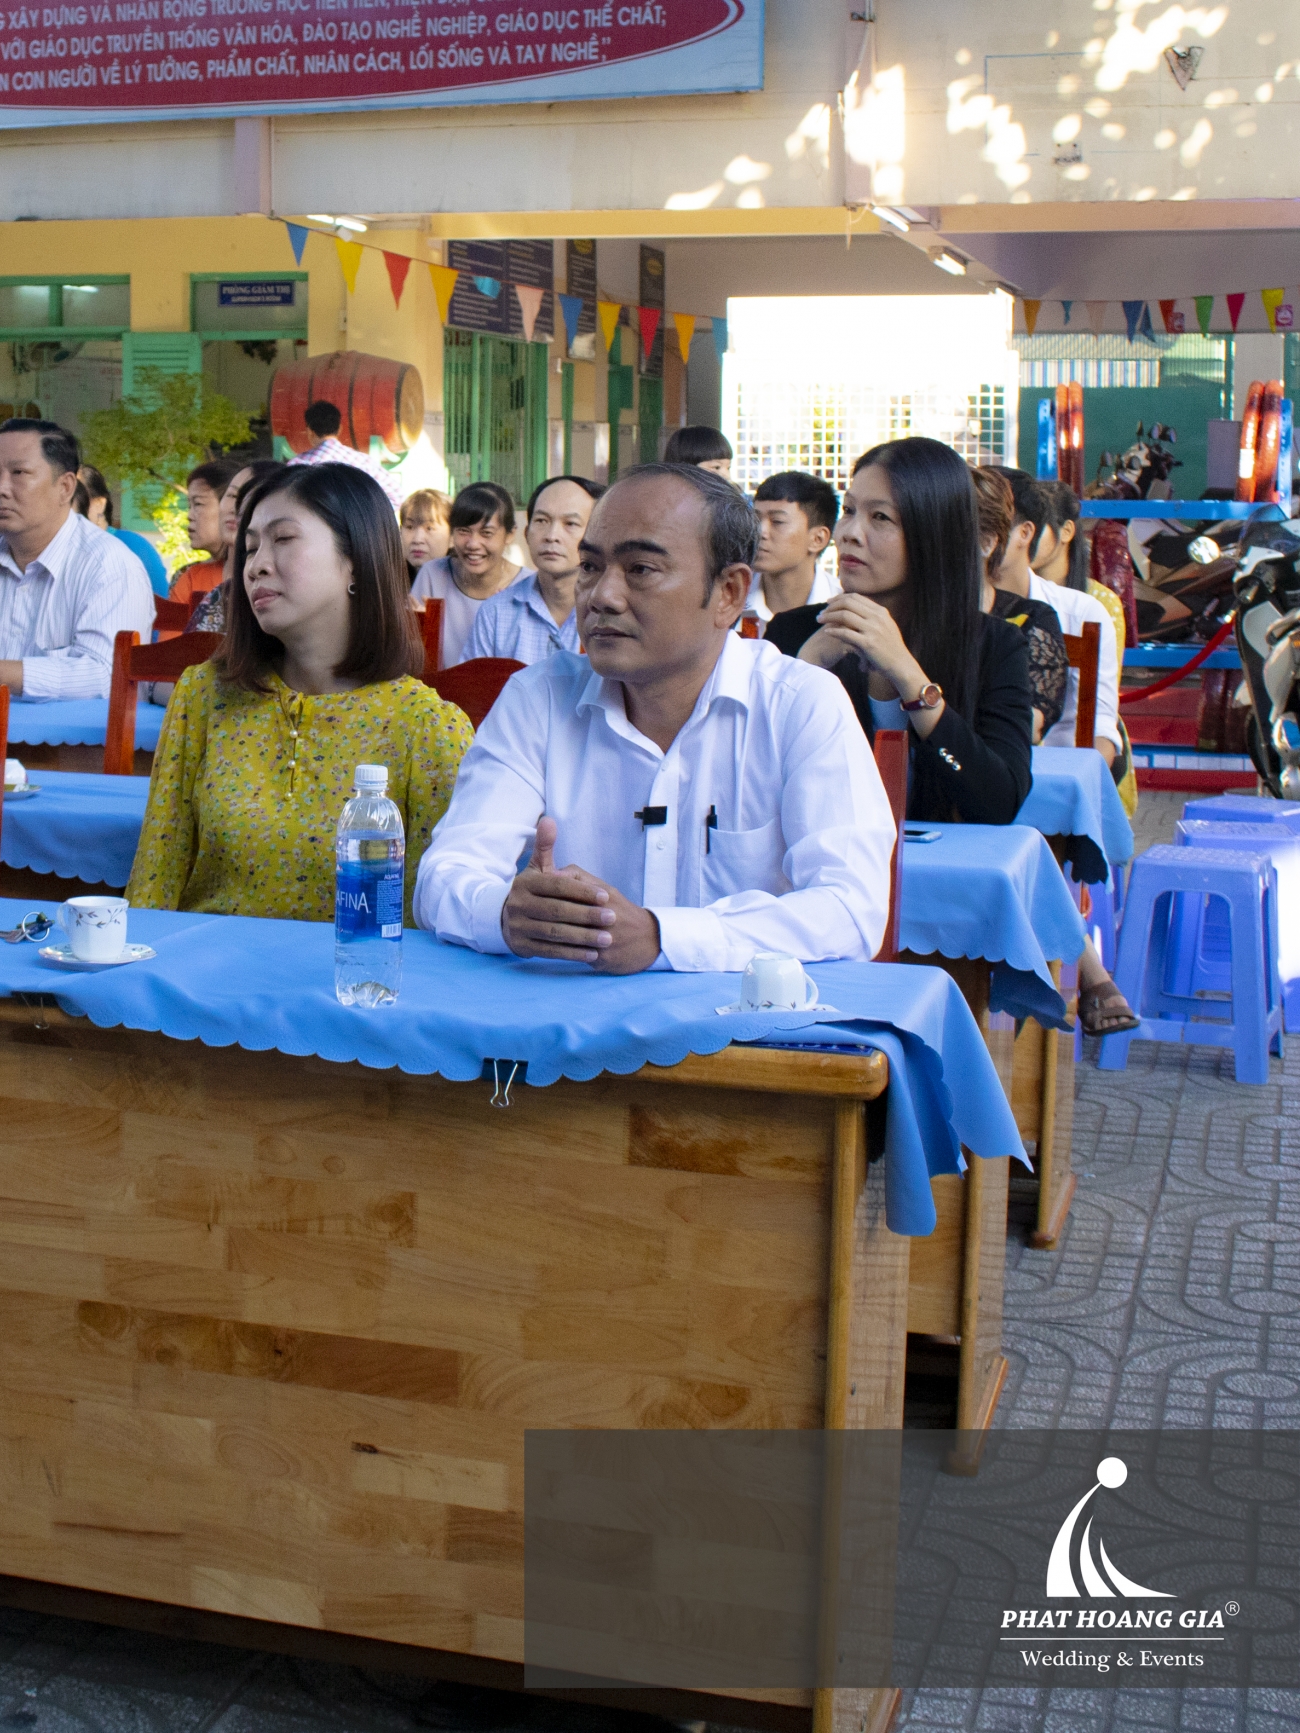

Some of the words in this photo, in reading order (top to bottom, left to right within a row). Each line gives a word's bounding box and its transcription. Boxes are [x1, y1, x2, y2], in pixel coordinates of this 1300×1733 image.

[1, 36, 26, 61] VỚI
[29, 33, 67, 57] GIÁO
[71, 35, 102, 58] DỤC
[107, 25, 164, 53] TRUYỀN
[168, 22, 219, 49] THỐNG
[224, 22, 257, 45] VĂN
[260, 19, 298, 44] HÓA,
[303, 17, 338, 42] ĐÀO
[341, 20, 372, 44] TẠO
[376, 10, 421, 39] NGHỀ
[426, 10, 491, 38] NGHIỆP,
[495, 7, 538, 33] GIÁO
[542, 10, 579, 34] DỤC
[584, 0, 613, 28] THỂ
[8, 6, 38, 29] XÂY
[43, 5, 87, 30] DỰNG
[12, 71, 44, 91] CON
[49, 63, 97, 88] NGƯỜI
[101, 58, 120, 85] VỀ
[124, 60, 142, 85] LÝ
[147, 54, 203, 82] TƯỞNG,
[207, 48, 252, 78] PHẨM
[255, 48, 300, 77] CHẤT,
[304, 50, 350, 74] NHÂN
[353, 47, 405, 73] CÁCH,
[409, 42, 434, 70] LỐI
[437, 41, 484, 69] SỐNG
[488, 41, 512, 65] VÀ
[515, 45, 546, 64] TAY
